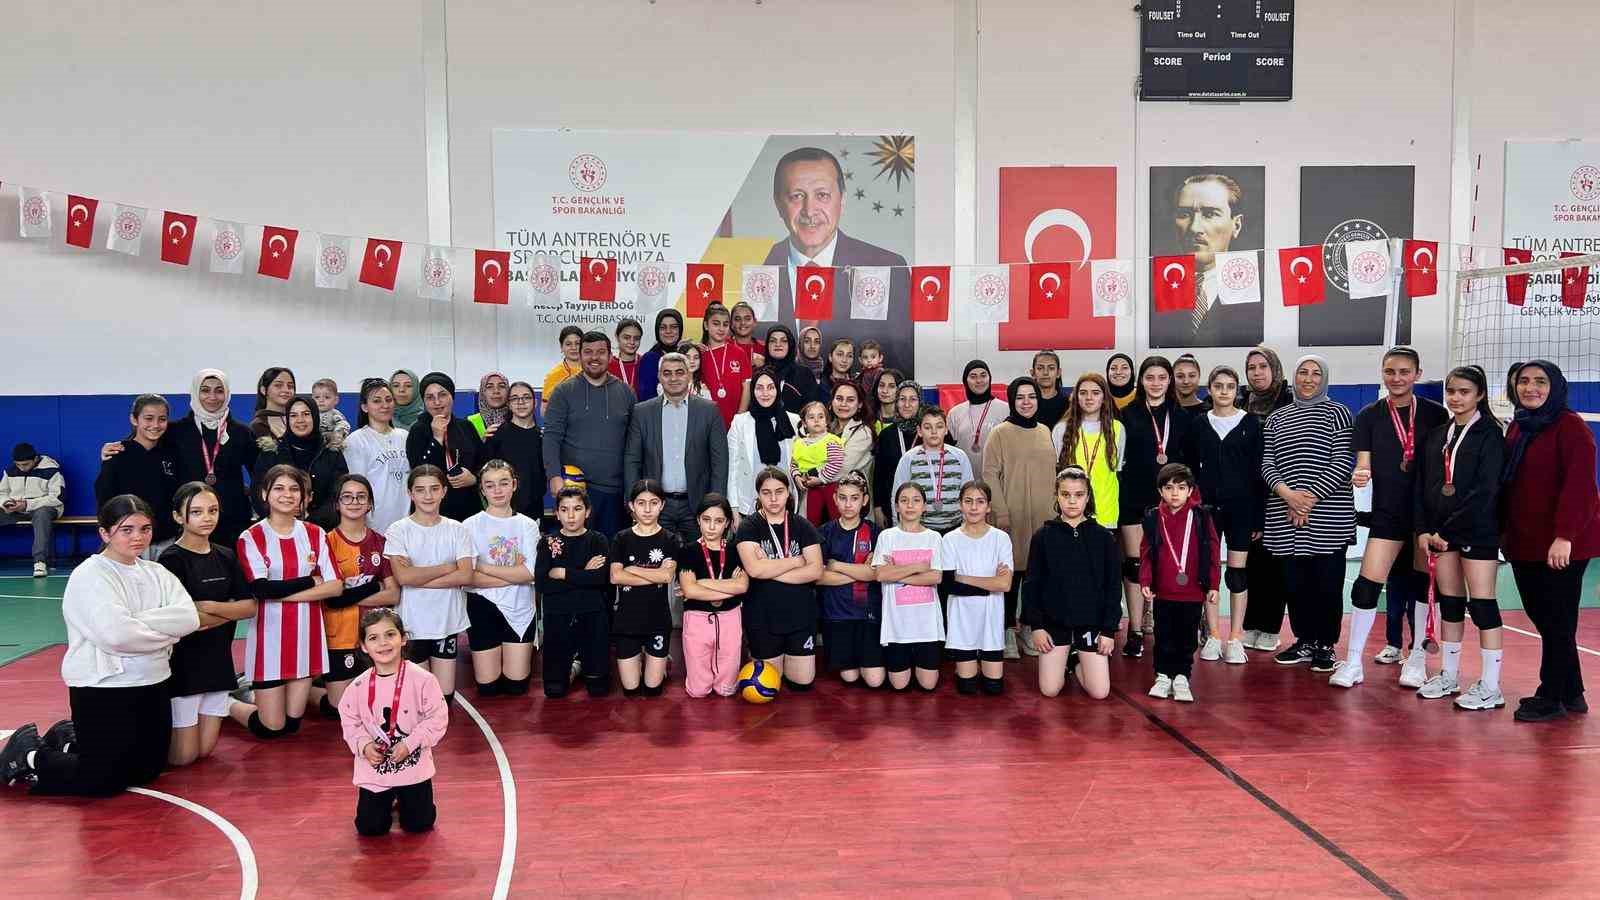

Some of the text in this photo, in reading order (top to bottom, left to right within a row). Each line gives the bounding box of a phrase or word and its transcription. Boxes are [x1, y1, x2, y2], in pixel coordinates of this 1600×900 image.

[1153, 57, 1183, 66] SCORE
[1202, 52, 1231, 61] Period
[1255, 58, 1284, 66] SCORE
[552, 195, 625, 205] T.C. GENÇLİK VE
[552, 205, 626, 215] SPOR BAKANLIĞI
[1553, 214, 1575, 222] SPOR
[506, 229, 671, 248] TÜM ANTRENÖR VE
[1512, 235, 1547, 251] TÜM
[1535, 294, 1548, 303] Dr.
[565, 301, 597, 311] Tayyip
[536, 314, 554, 323] T.C.
[436, 638, 456, 654] 13
[653, 635, 664, 650] 3
[803, 635, 814, 650] 4
